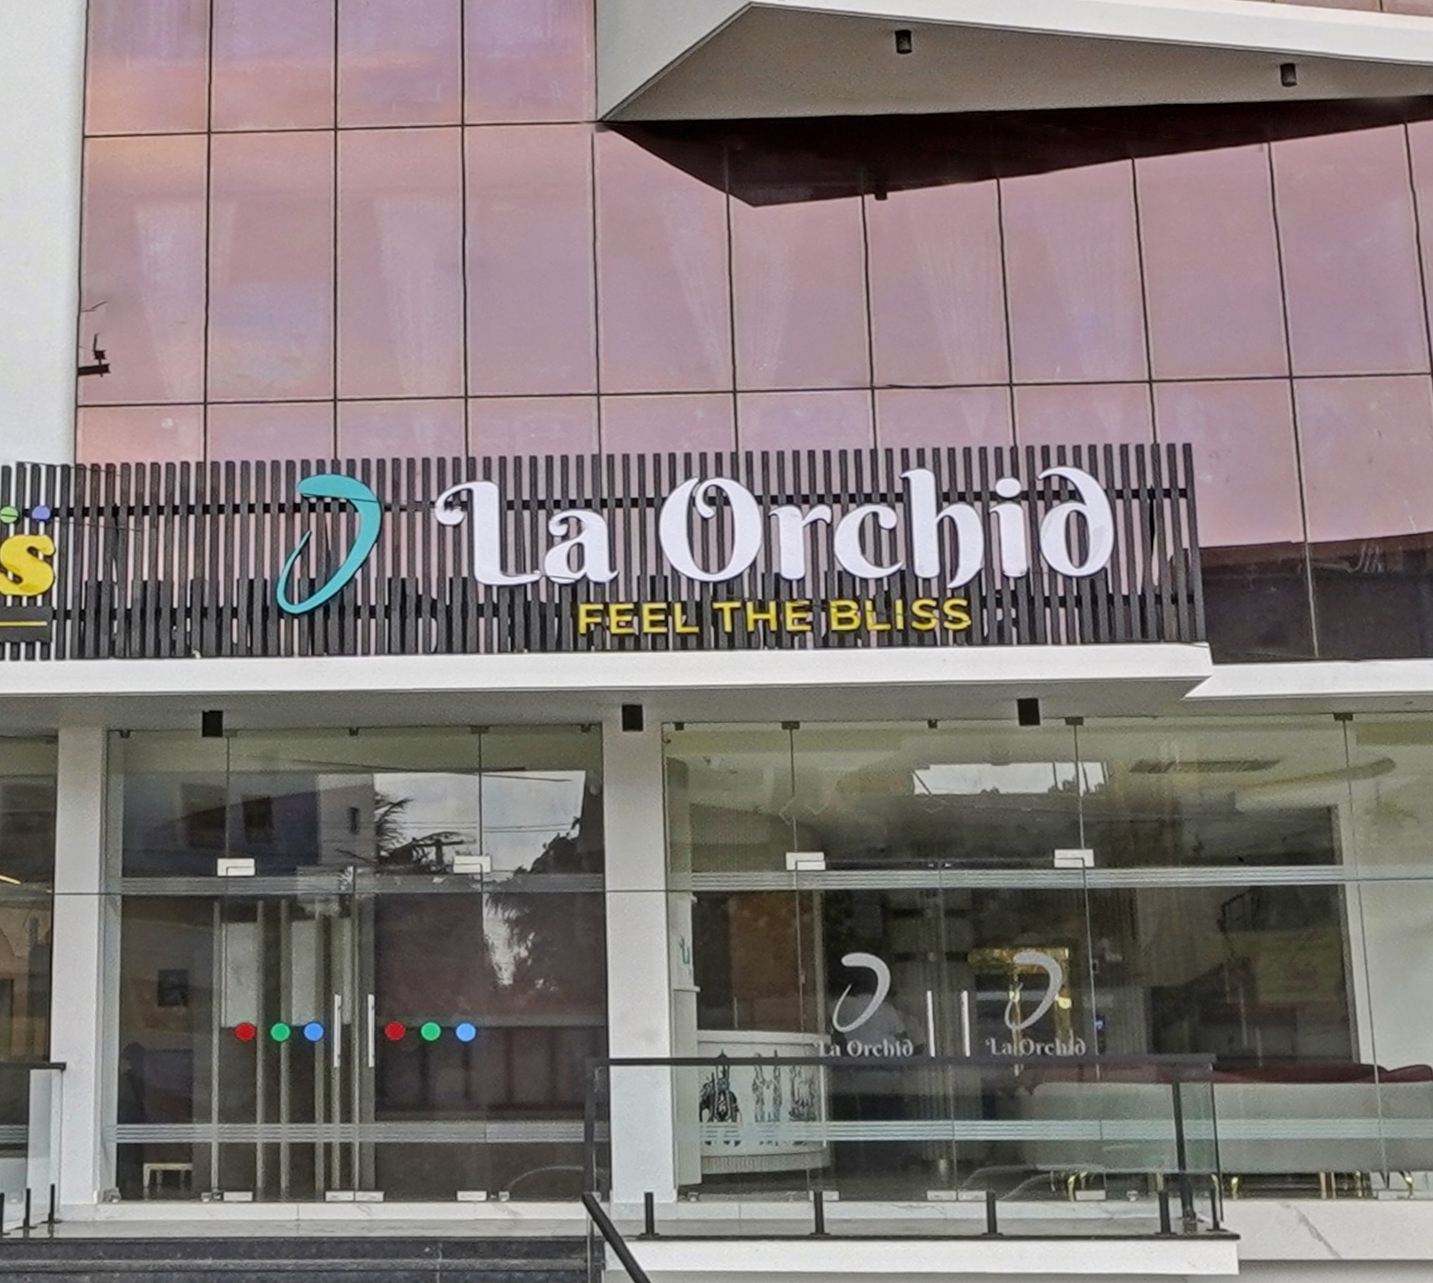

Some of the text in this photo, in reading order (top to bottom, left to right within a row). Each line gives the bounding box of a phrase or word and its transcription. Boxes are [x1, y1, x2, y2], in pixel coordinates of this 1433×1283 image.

[435, 466, 1113, 588] La Orchid
[578, 596, 971, 635] FEEL THE BLISS
[814, 1038, 914, 1059] La Orchid
[986, 1038, 1087, 1057] La Orchid
